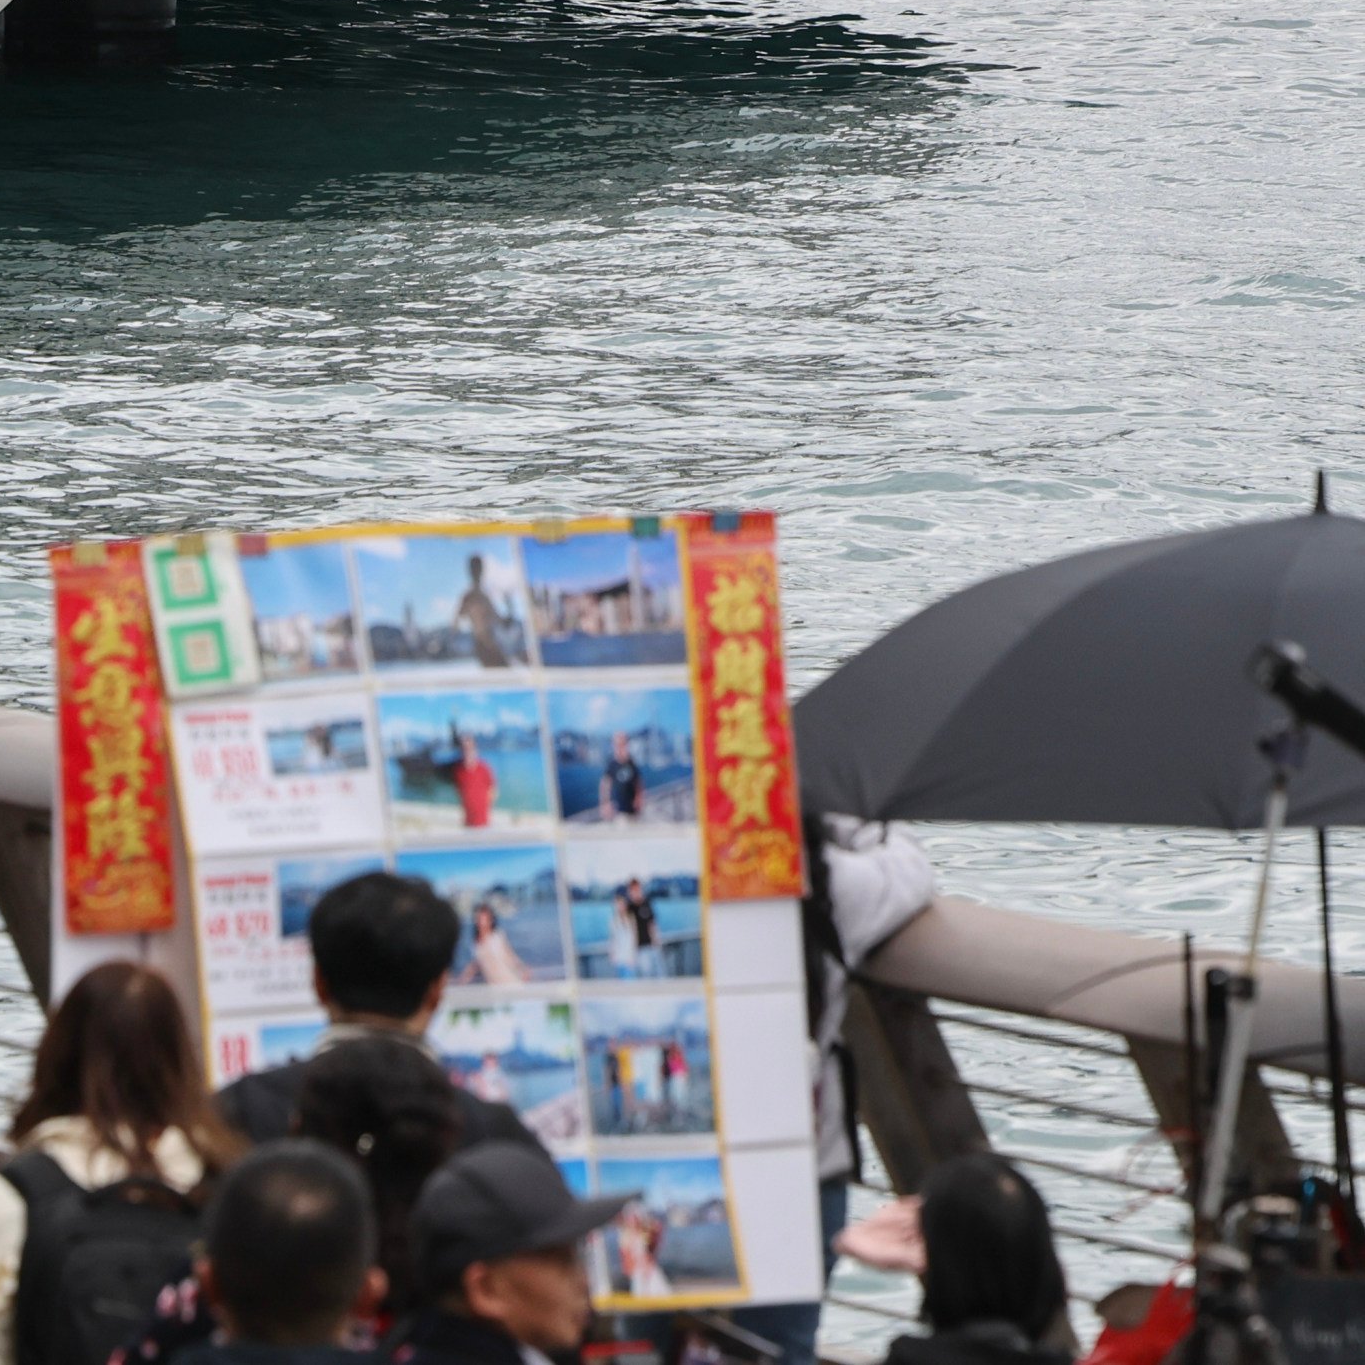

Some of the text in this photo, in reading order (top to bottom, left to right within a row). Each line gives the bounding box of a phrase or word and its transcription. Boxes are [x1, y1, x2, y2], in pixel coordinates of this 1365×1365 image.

[73, 596, 156, 861] 生意興隆
[706, 574, 778, 826] 招財進寶
